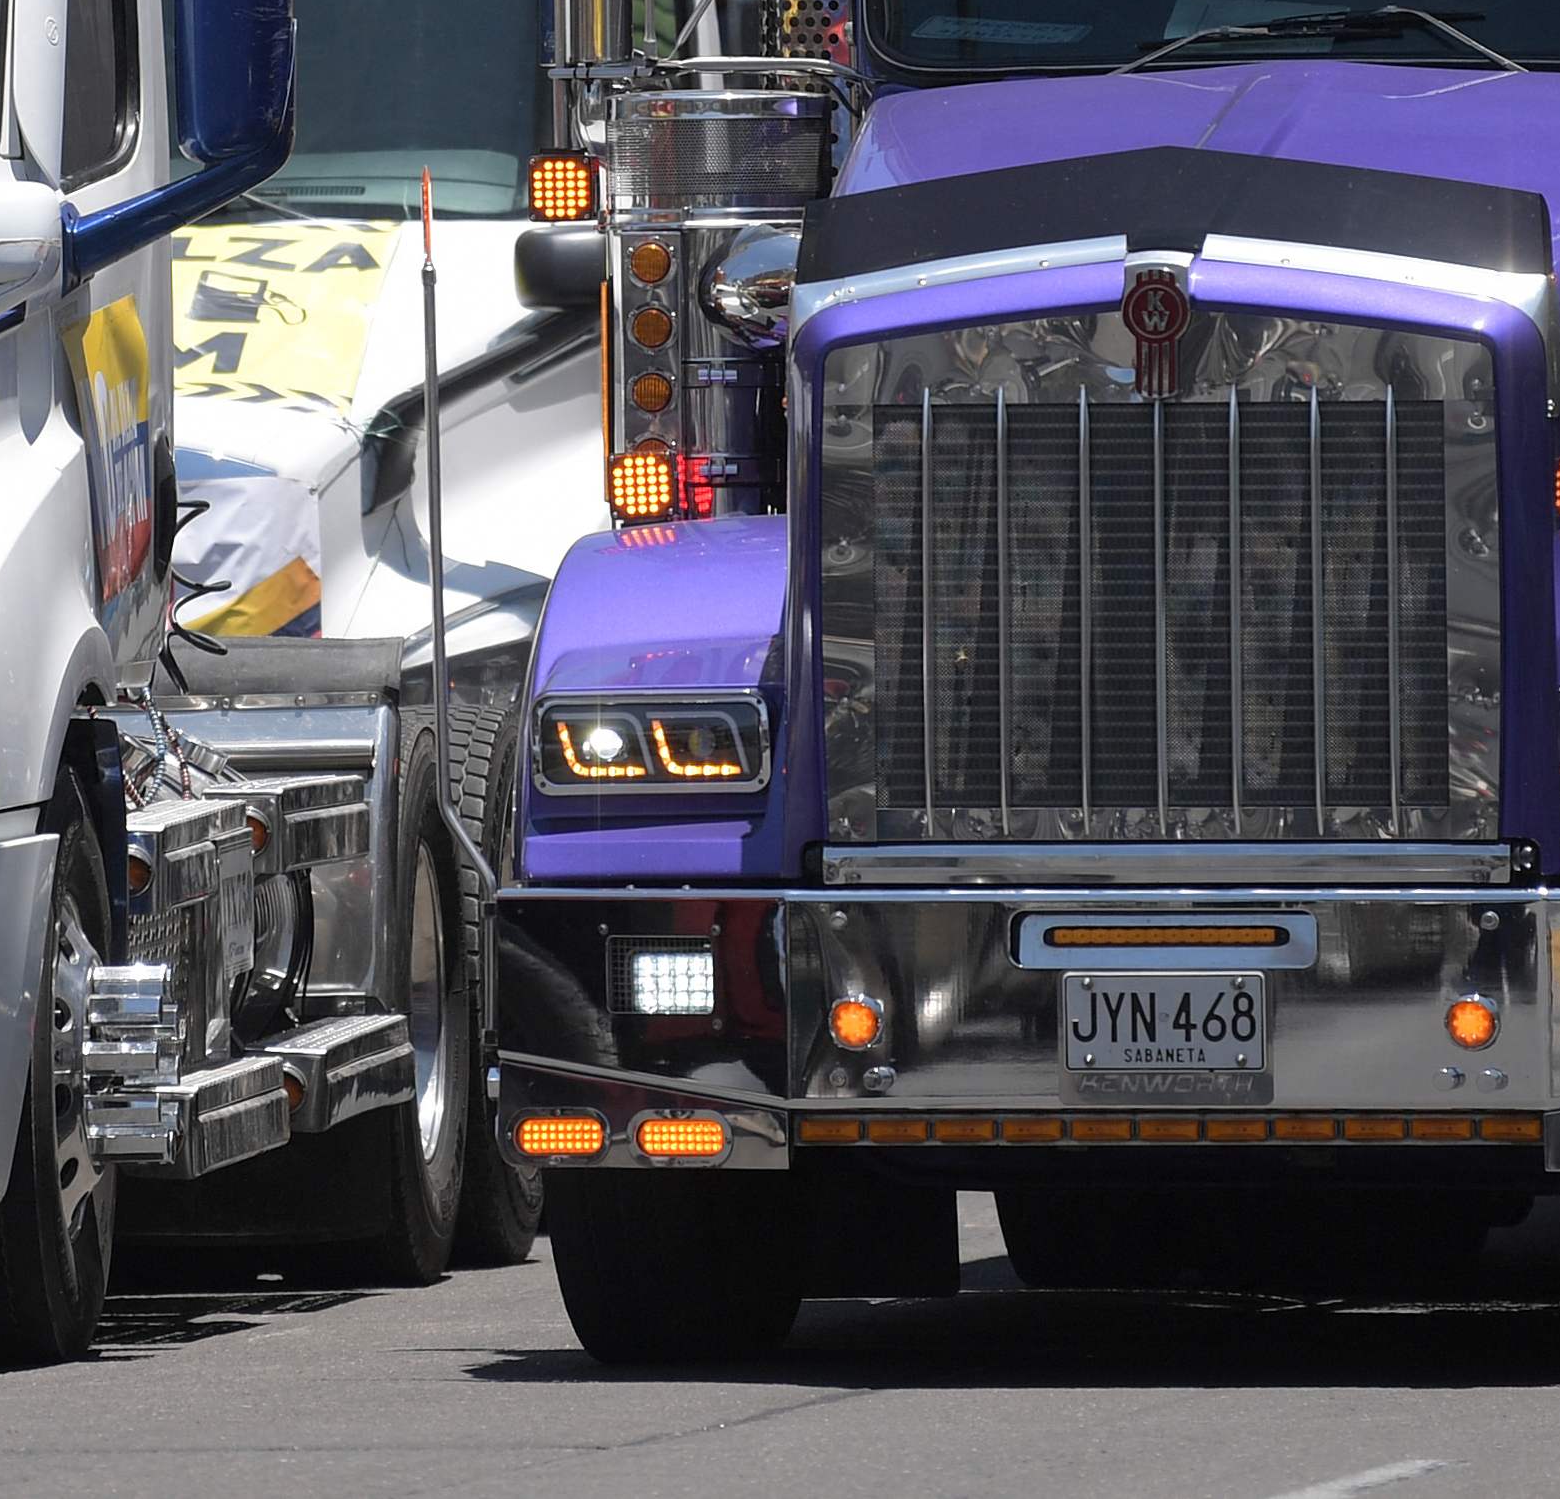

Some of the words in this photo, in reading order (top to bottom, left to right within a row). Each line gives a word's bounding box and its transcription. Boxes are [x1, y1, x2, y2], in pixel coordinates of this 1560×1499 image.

[1072, 991, 1157, 1043] JYN
[1172, 991, 1257, 1043] 468
[1123, 1048, 1206, 1063] SABANETA
[1078, 1073, 1254, 1093] KENWORTH
